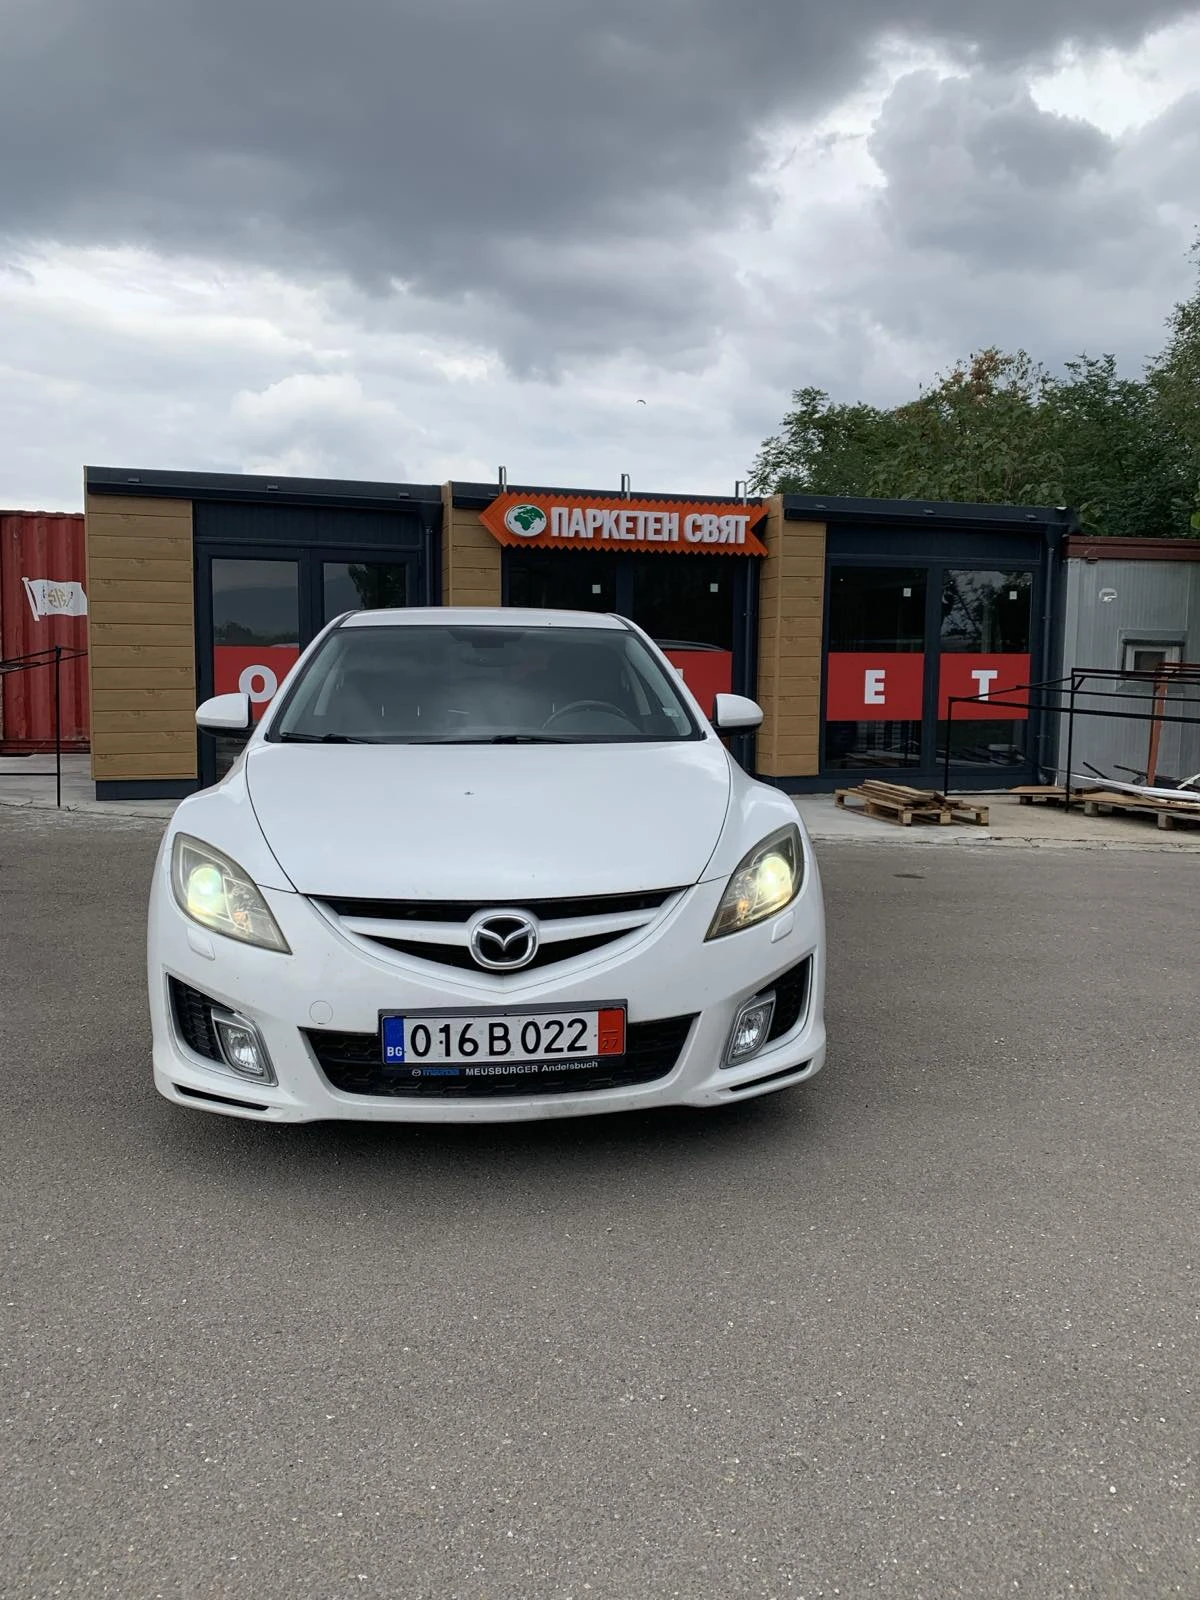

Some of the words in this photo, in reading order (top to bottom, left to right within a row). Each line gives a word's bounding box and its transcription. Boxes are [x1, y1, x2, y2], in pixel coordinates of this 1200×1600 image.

[550, 506, 680, 542] ПАРКЕТЕН
[684, 513, 750, 544] СВЯТ
[386, 1046, 403, 1057] BG
[465, 1065, 538, 1076] MEUSBURGER
